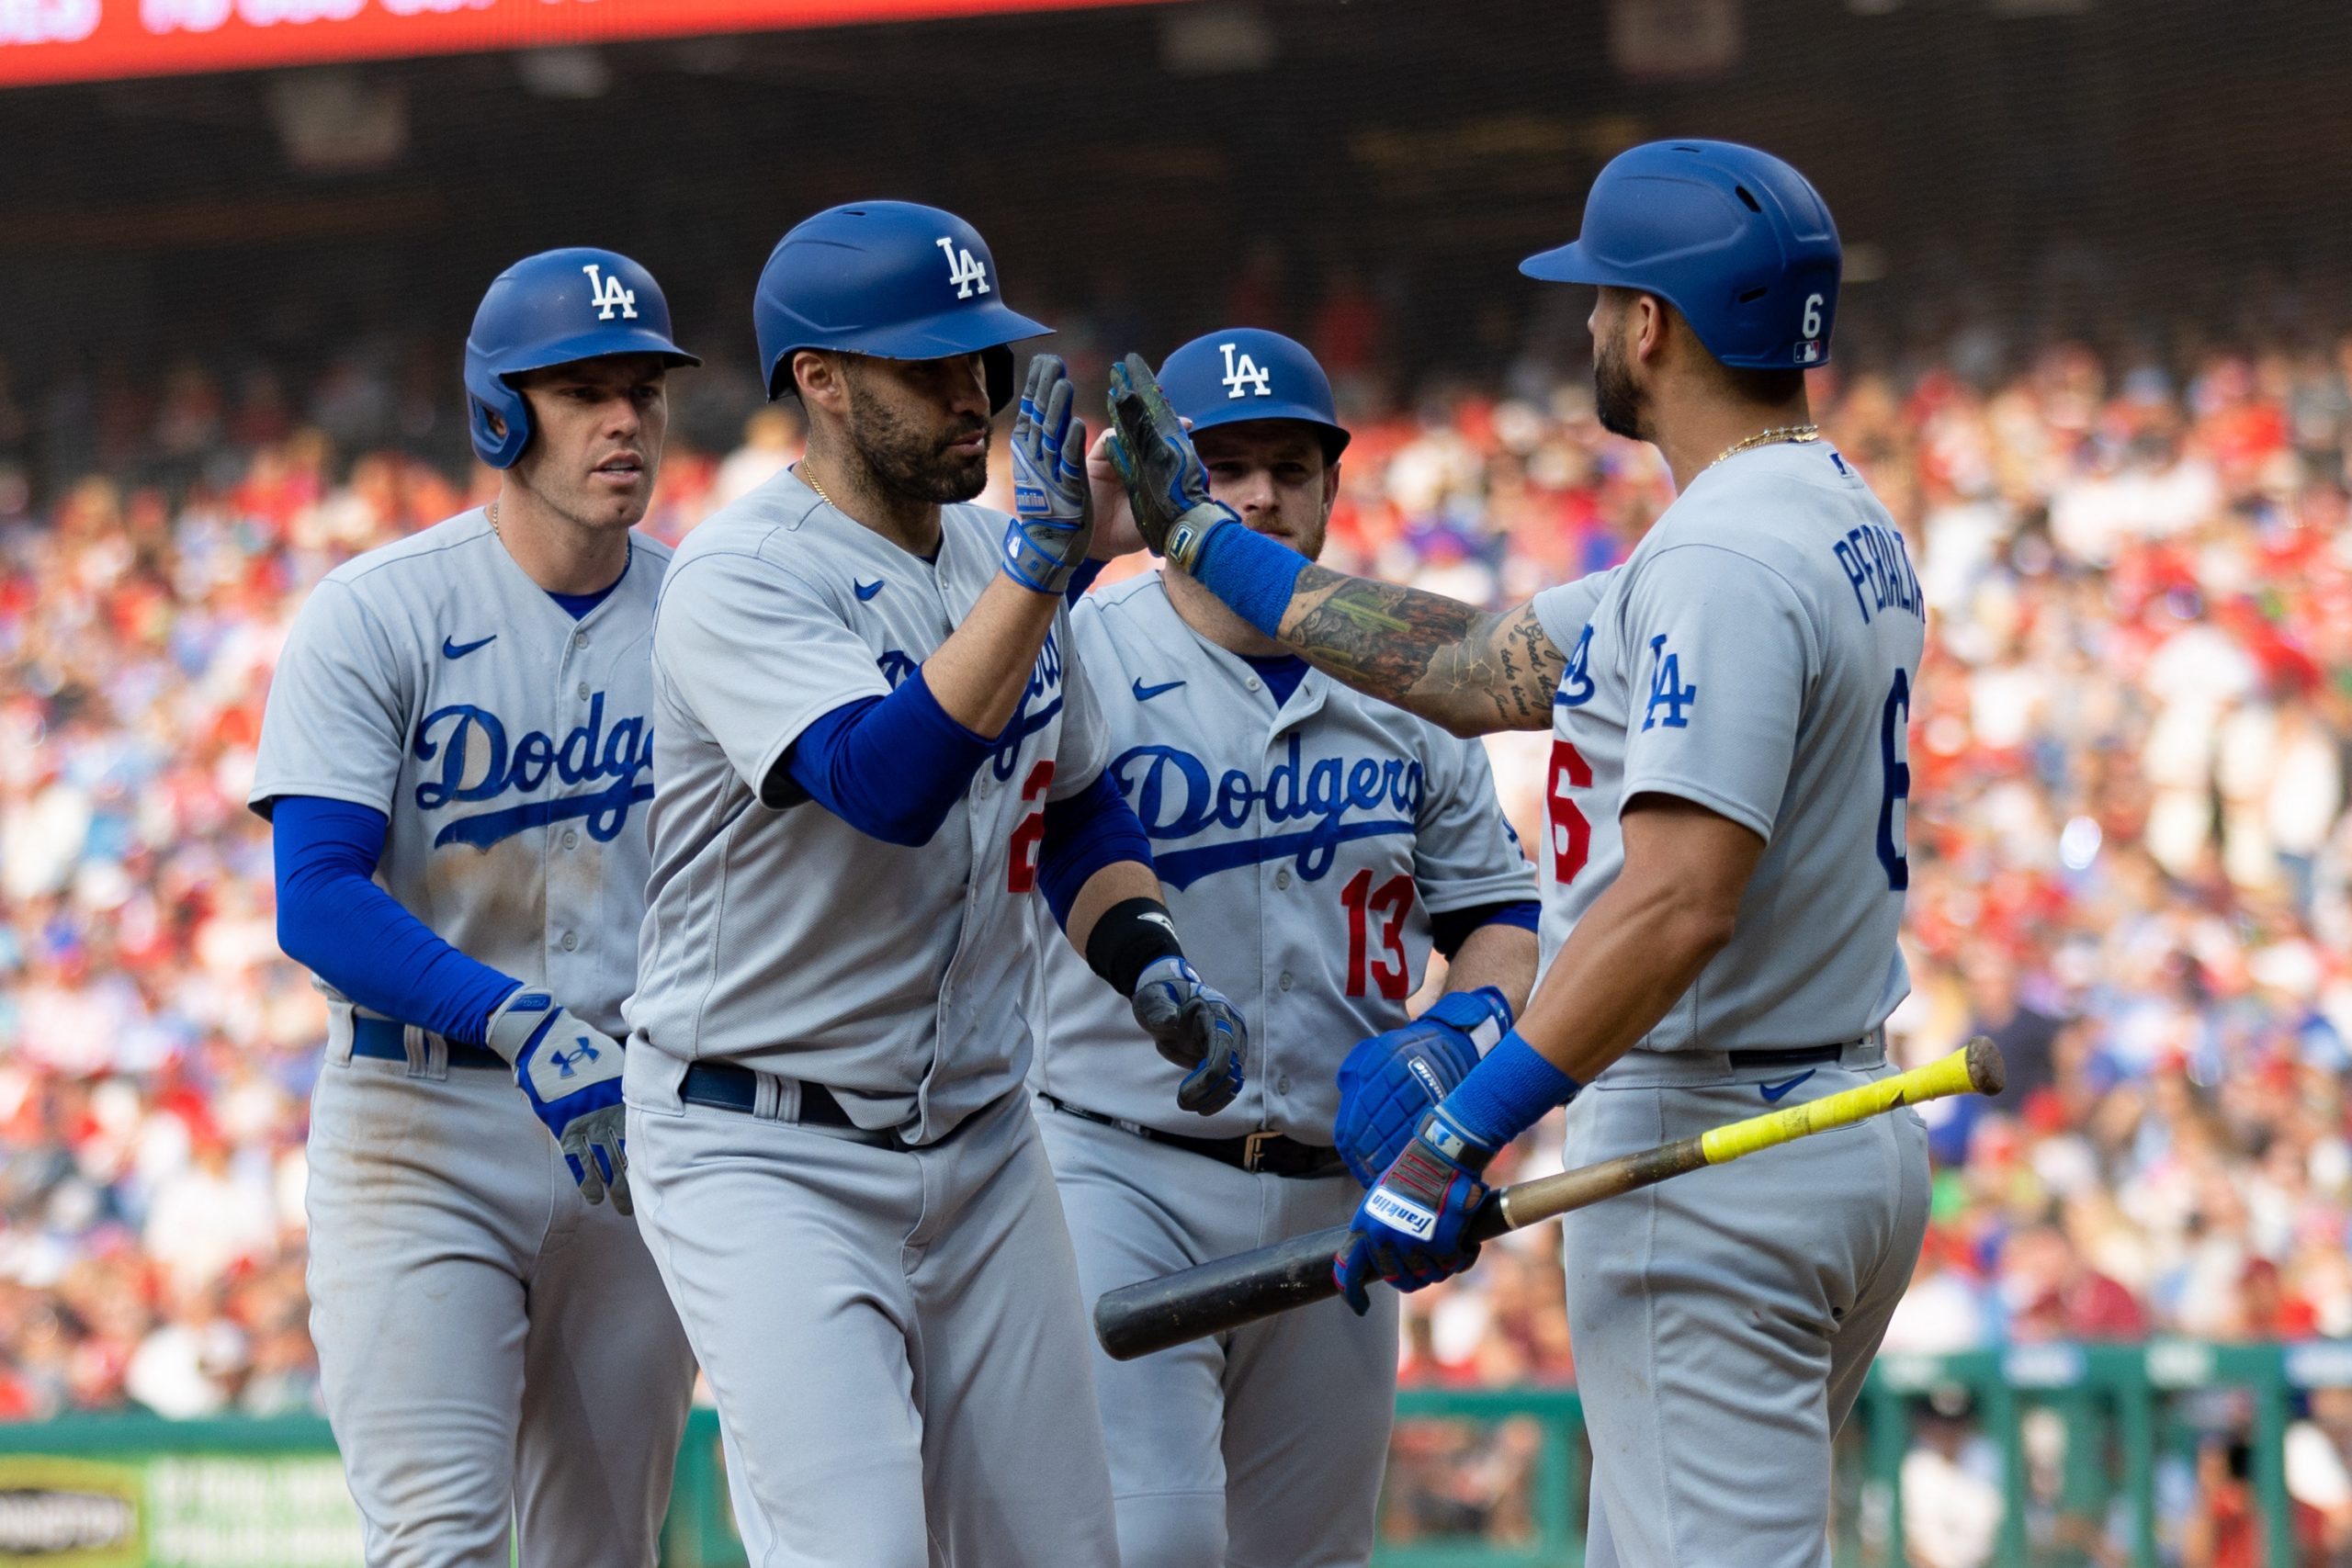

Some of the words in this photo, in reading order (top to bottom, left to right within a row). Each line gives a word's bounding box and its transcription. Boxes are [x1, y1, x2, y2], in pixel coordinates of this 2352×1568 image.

[582, 264, 638, 321] LA
[936, 237, 990, 299] LA
[1802, 293, 1824, 339] 6
[1219, 343, 1272, 399] LA
[1642, 634, 1697, 733] LA
[413, 691, 655, 843] Dodg
[1546, 739, 1593, 886] 6
[1340, 868, 1417, 1000] 13
